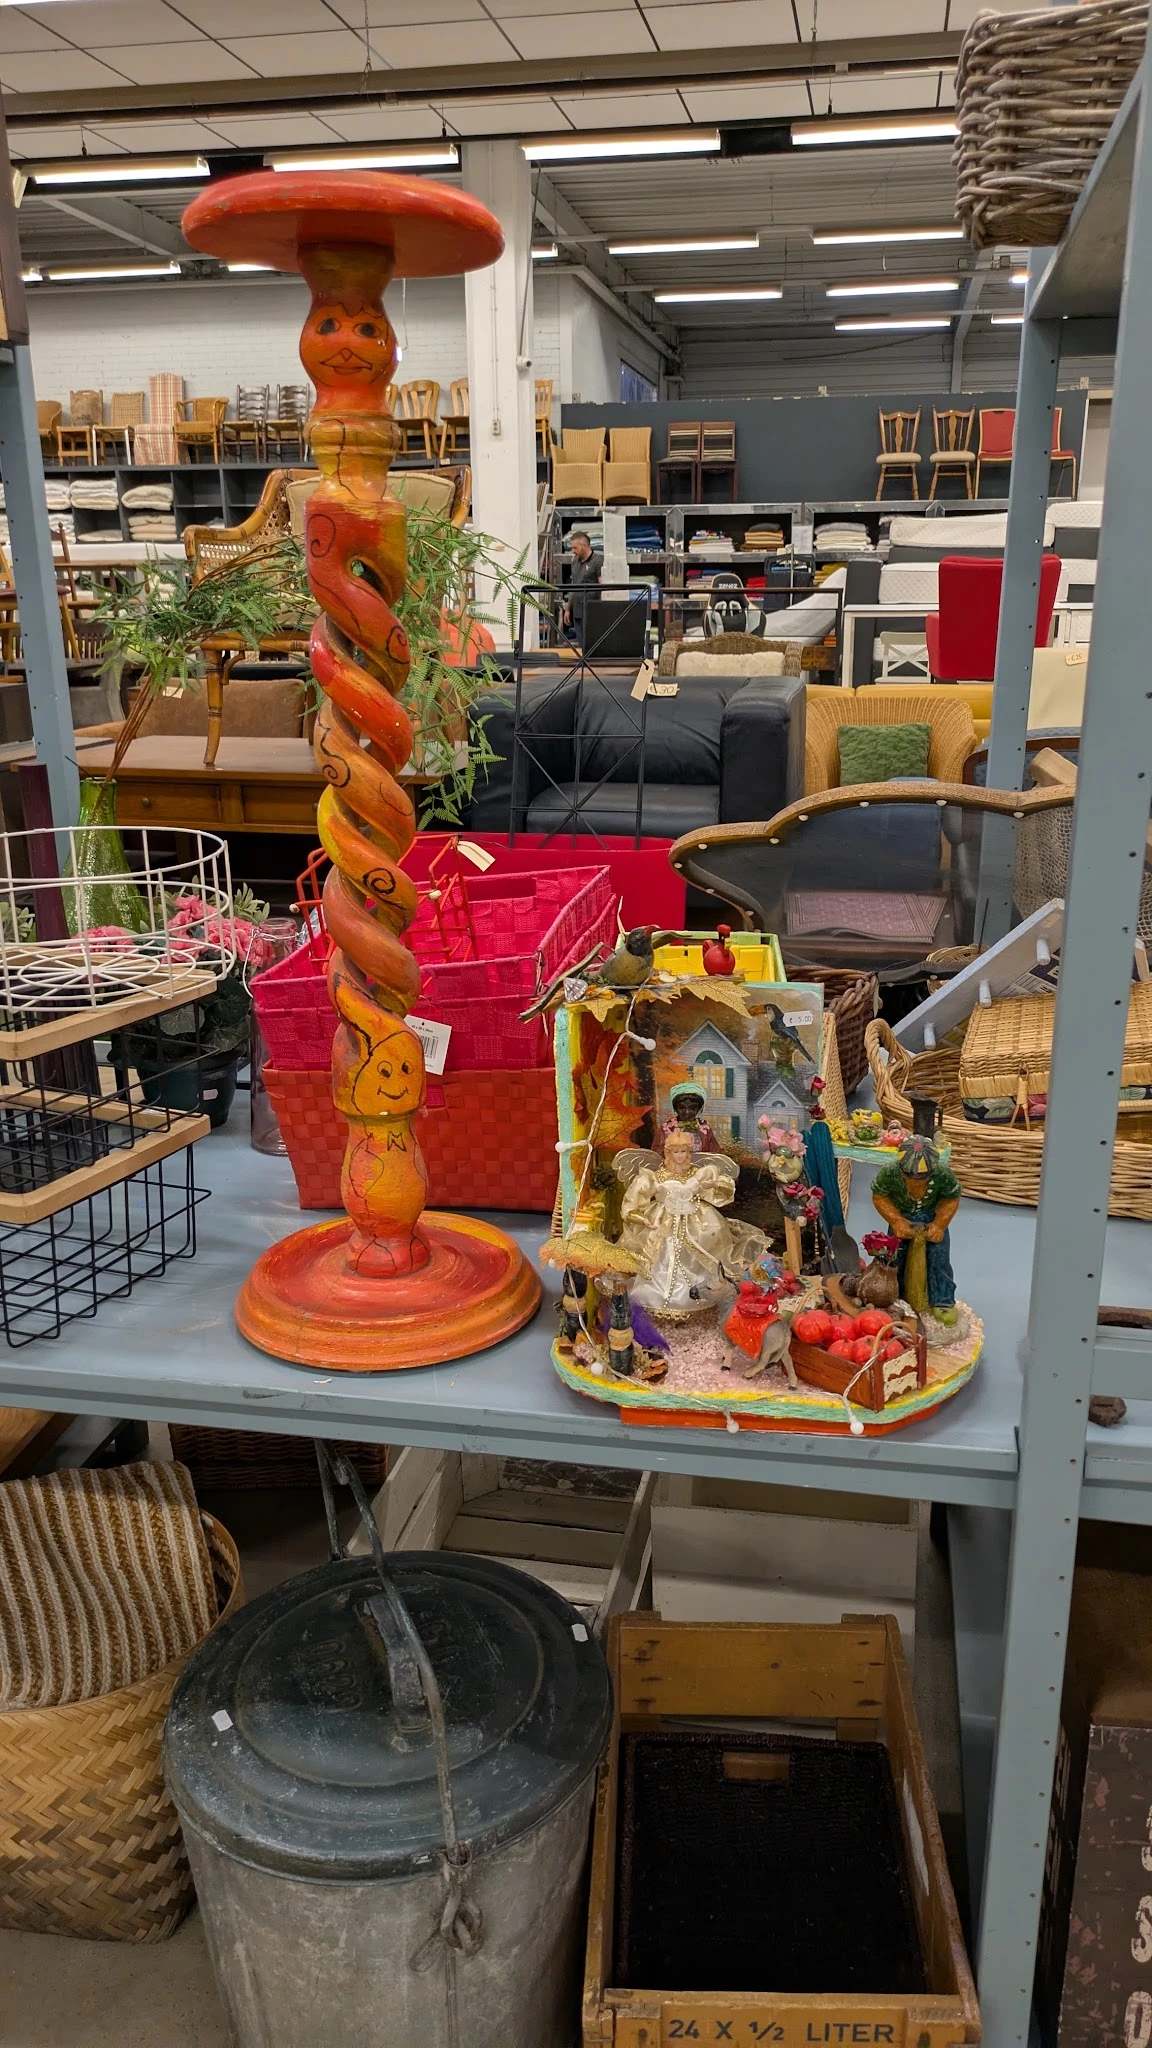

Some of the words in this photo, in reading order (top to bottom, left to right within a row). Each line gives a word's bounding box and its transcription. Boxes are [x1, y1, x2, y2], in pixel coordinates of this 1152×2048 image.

[668, 2019, 700, 2039] 24
[715, 2020, 734, 2040] X
[806, 2022, 895, 2044] LITER
